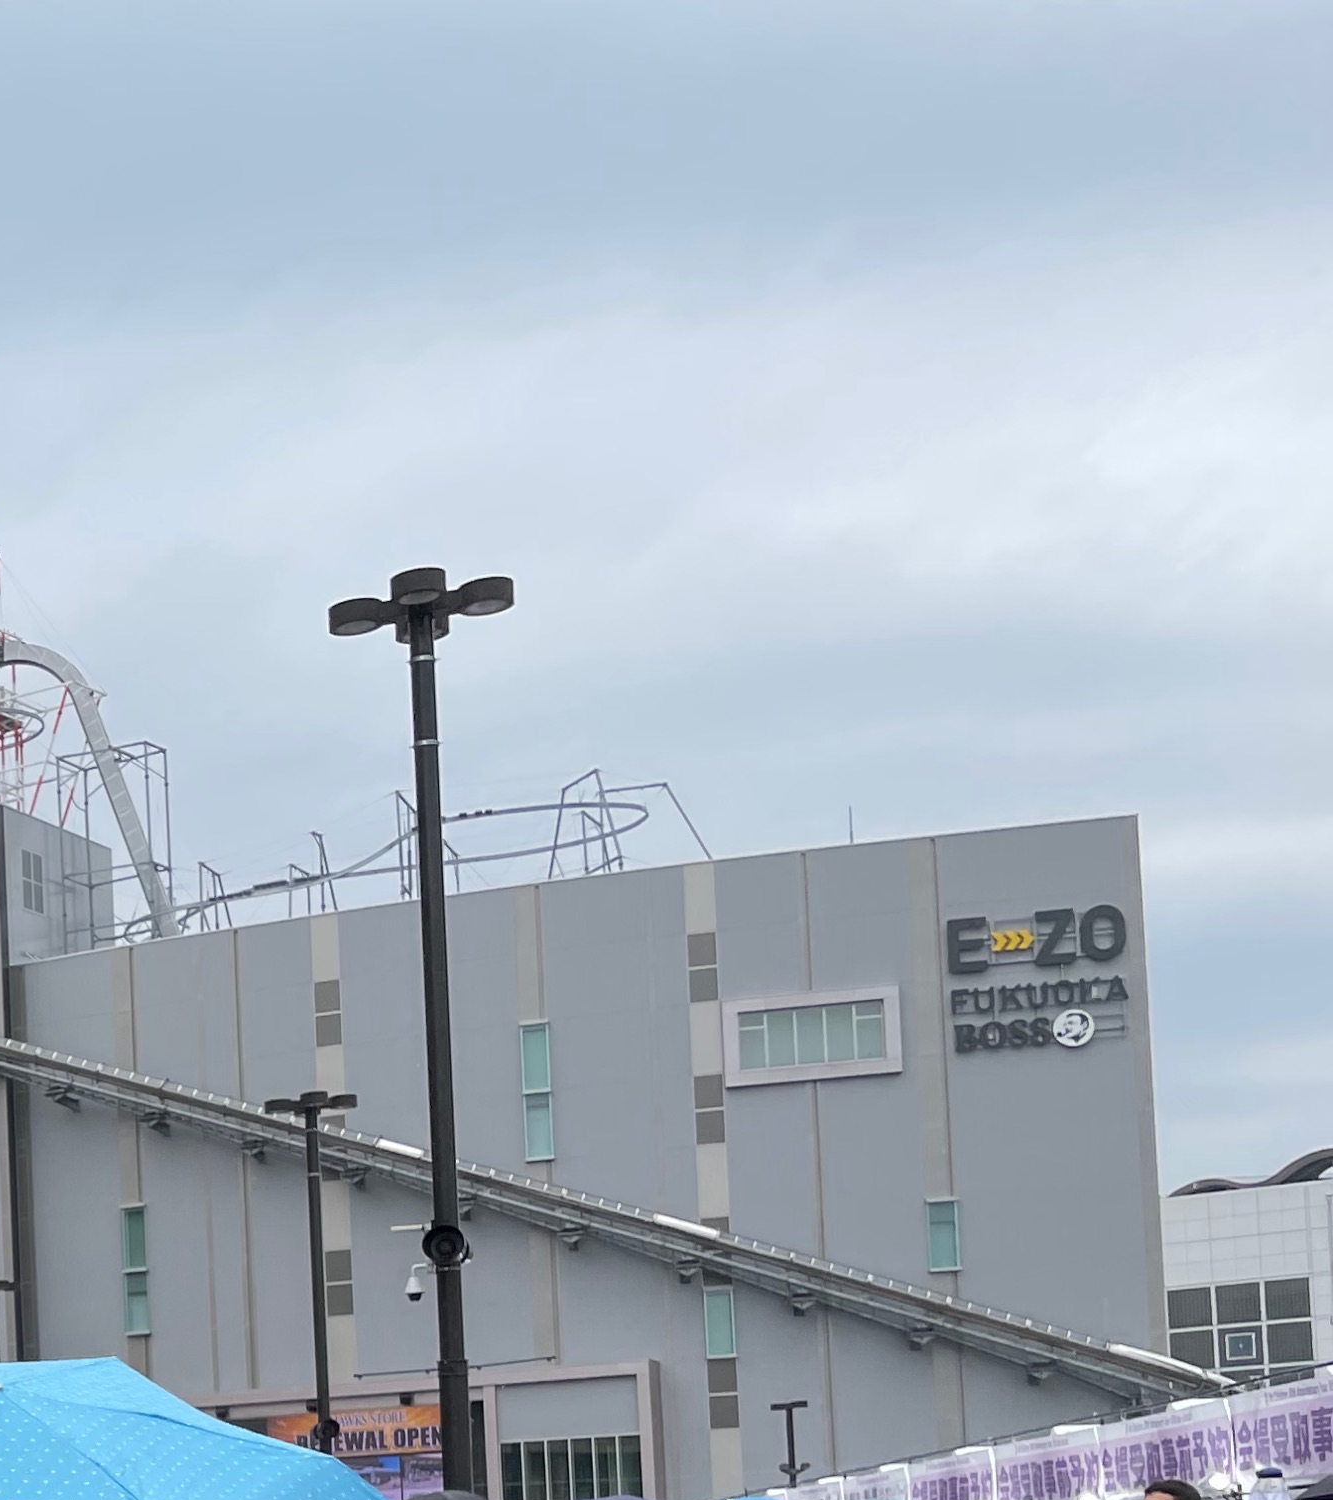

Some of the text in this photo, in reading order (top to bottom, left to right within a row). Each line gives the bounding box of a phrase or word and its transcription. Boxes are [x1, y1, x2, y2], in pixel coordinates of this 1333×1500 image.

[950, 975, 1129, 1015] FUKUOKA
[953, 1017, 1052, 1055] BOSS
[335, 1410, 406, 1427] AWKS STORE
[296, 1431, 388, 1451] REEWAL
